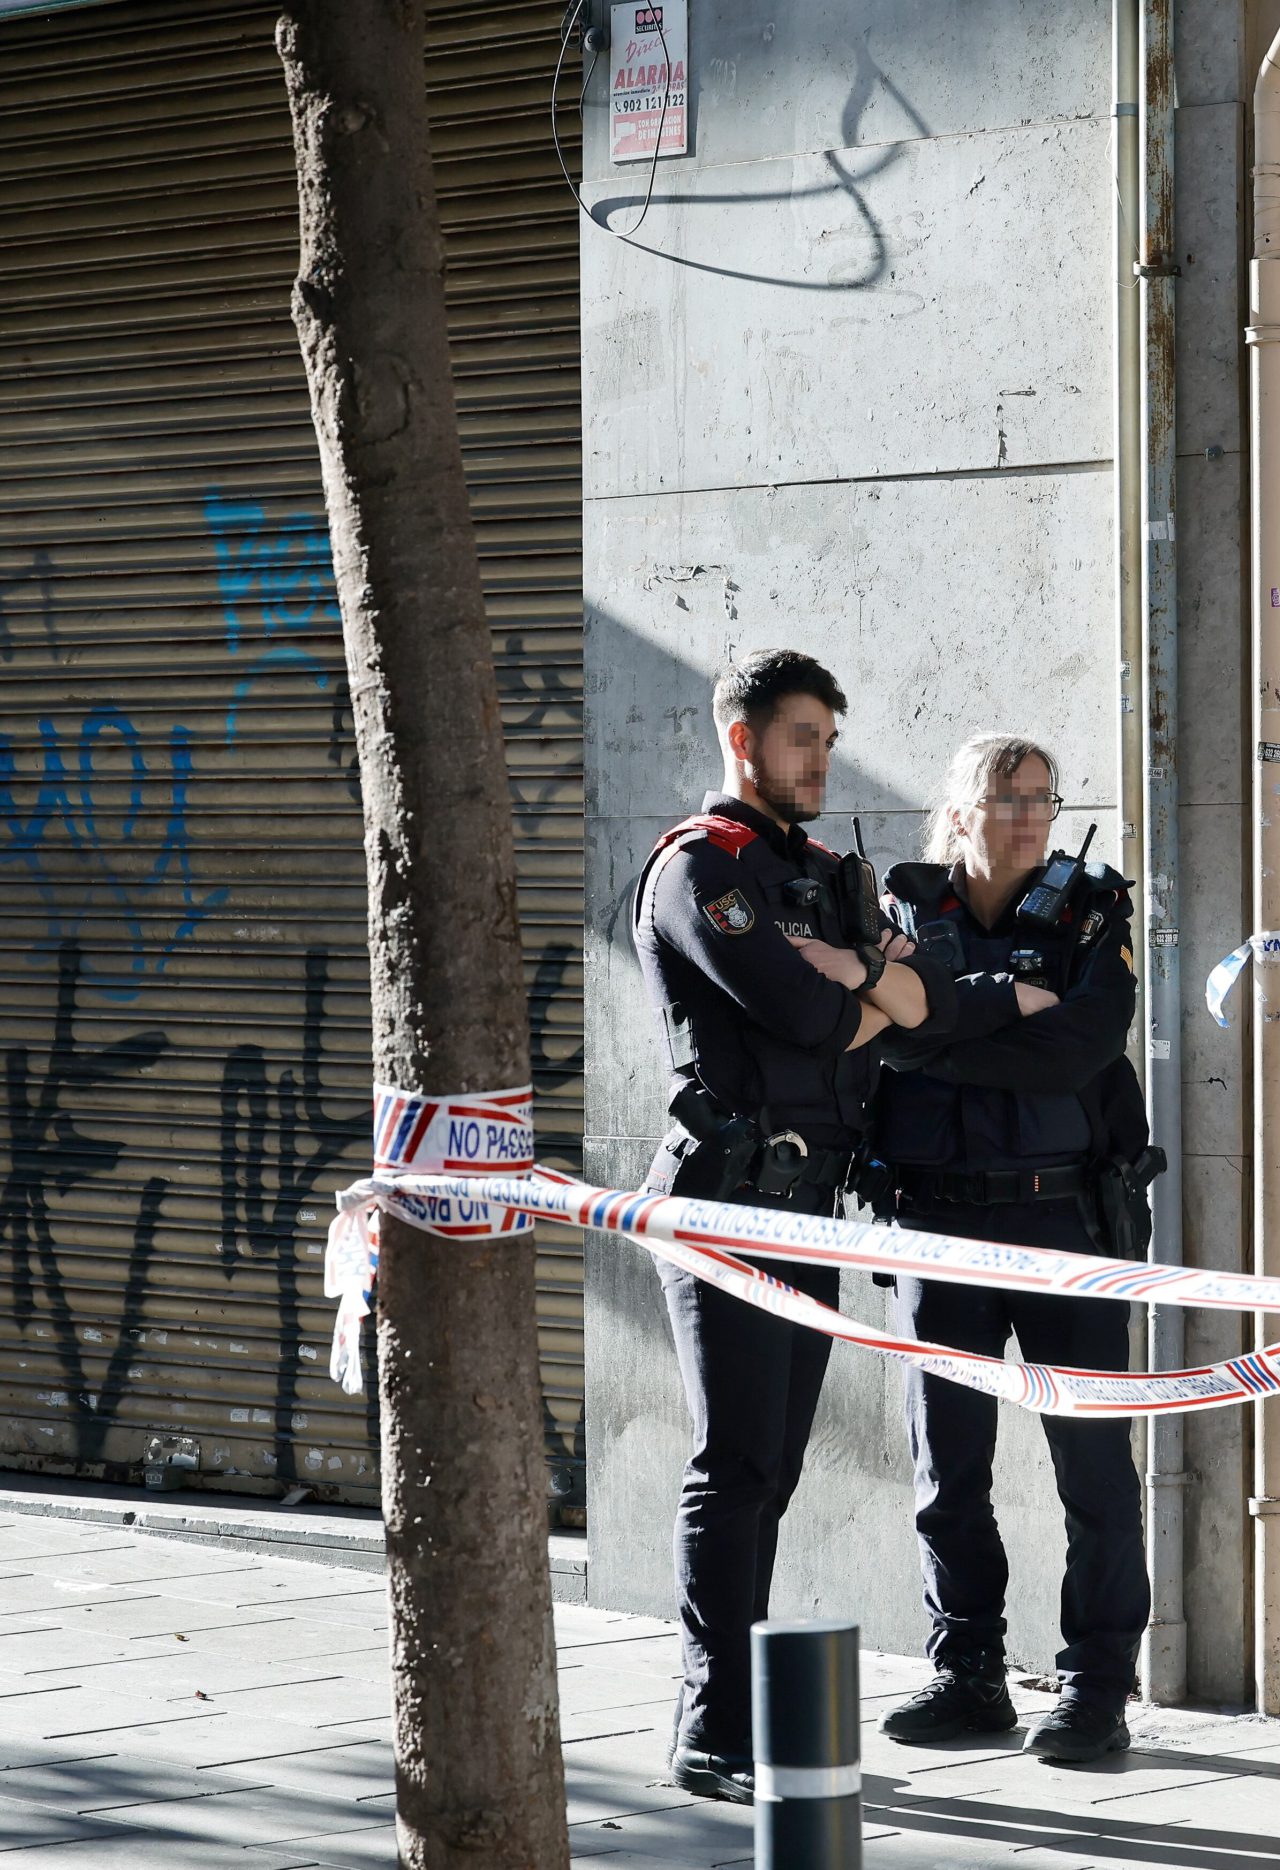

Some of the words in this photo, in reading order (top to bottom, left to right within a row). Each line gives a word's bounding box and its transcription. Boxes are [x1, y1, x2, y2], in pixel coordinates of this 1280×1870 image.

[614, 61, 684, 89] ALARMA
[624, 98, 641, 113] 902
[646, 96, 663, 110] 121
[716, 894, 736, 910] USC
[448, 1120, 480, 1159] NO
[545, 1184, 567, 1210] NO
[458, 1199, 490, 1223] NO
